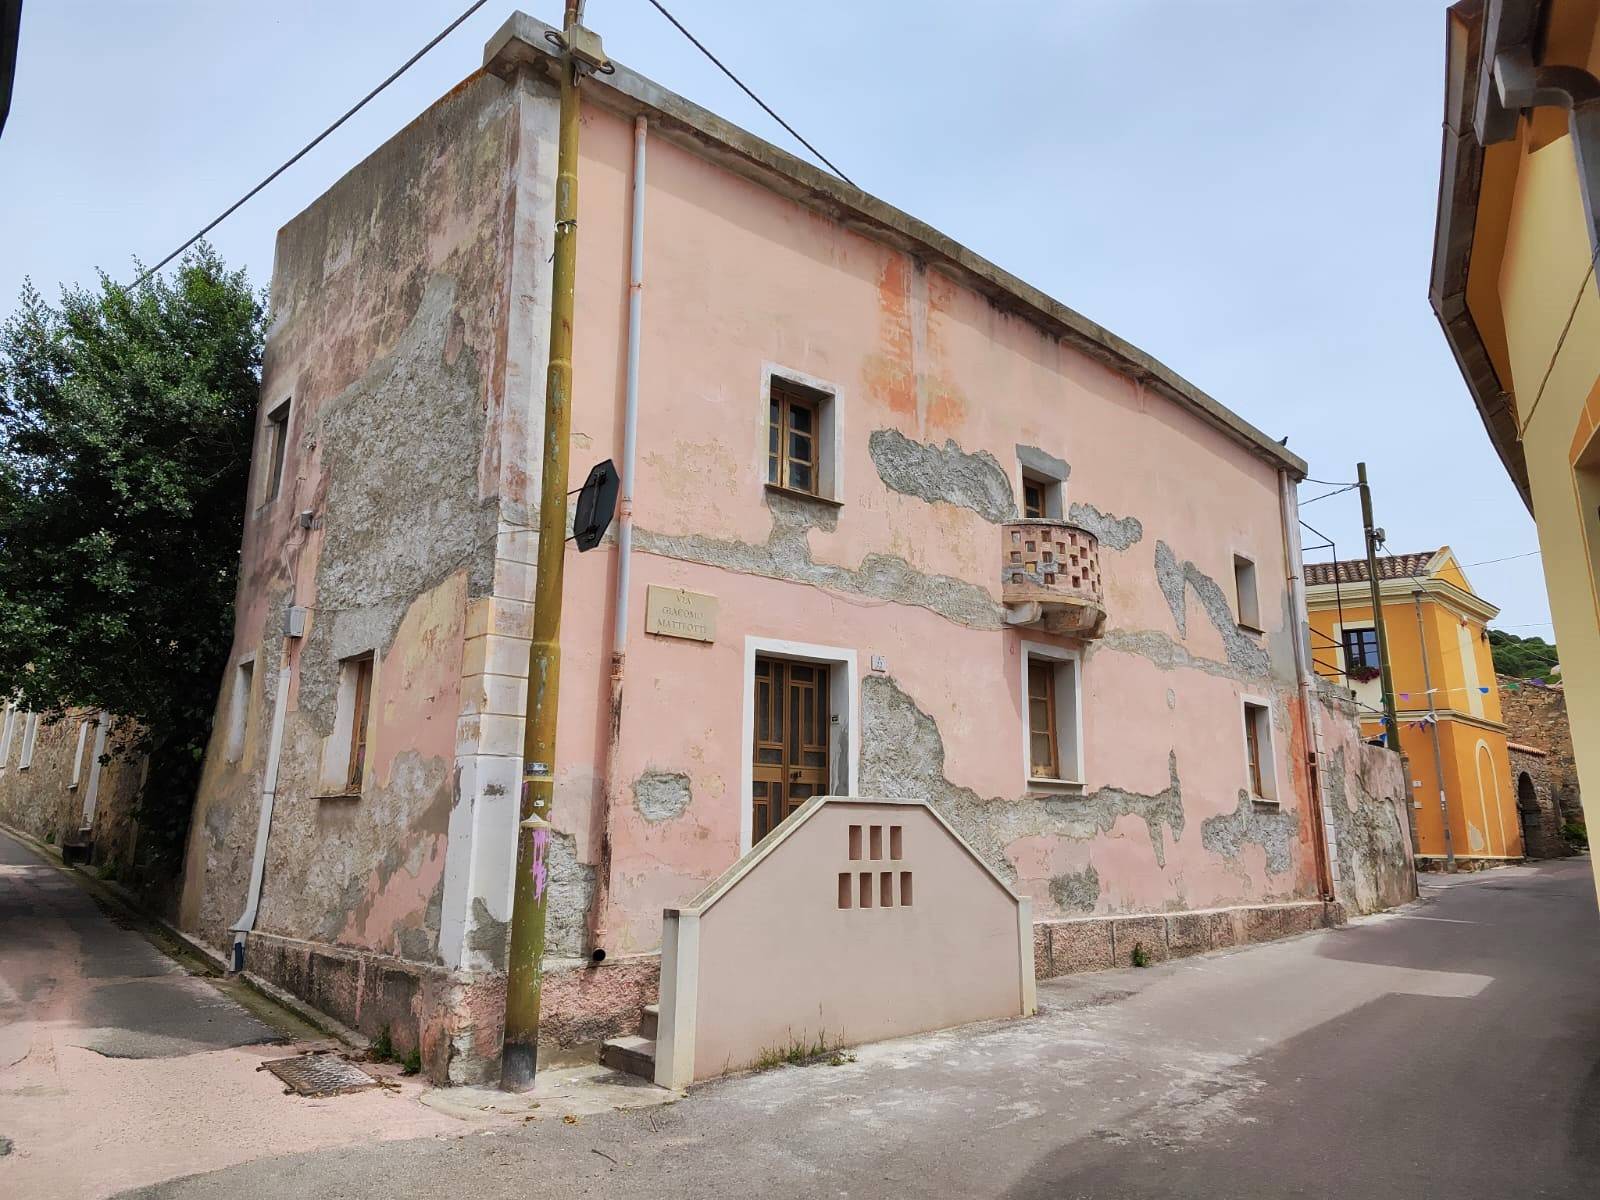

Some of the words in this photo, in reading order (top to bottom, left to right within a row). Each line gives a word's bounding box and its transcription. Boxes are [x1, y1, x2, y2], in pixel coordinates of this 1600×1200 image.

[676, 595, 691, 605] VIA
[662, 606, 704, 619] GIACOMO
[656, 618, 707, 633] MATTEOTTI
